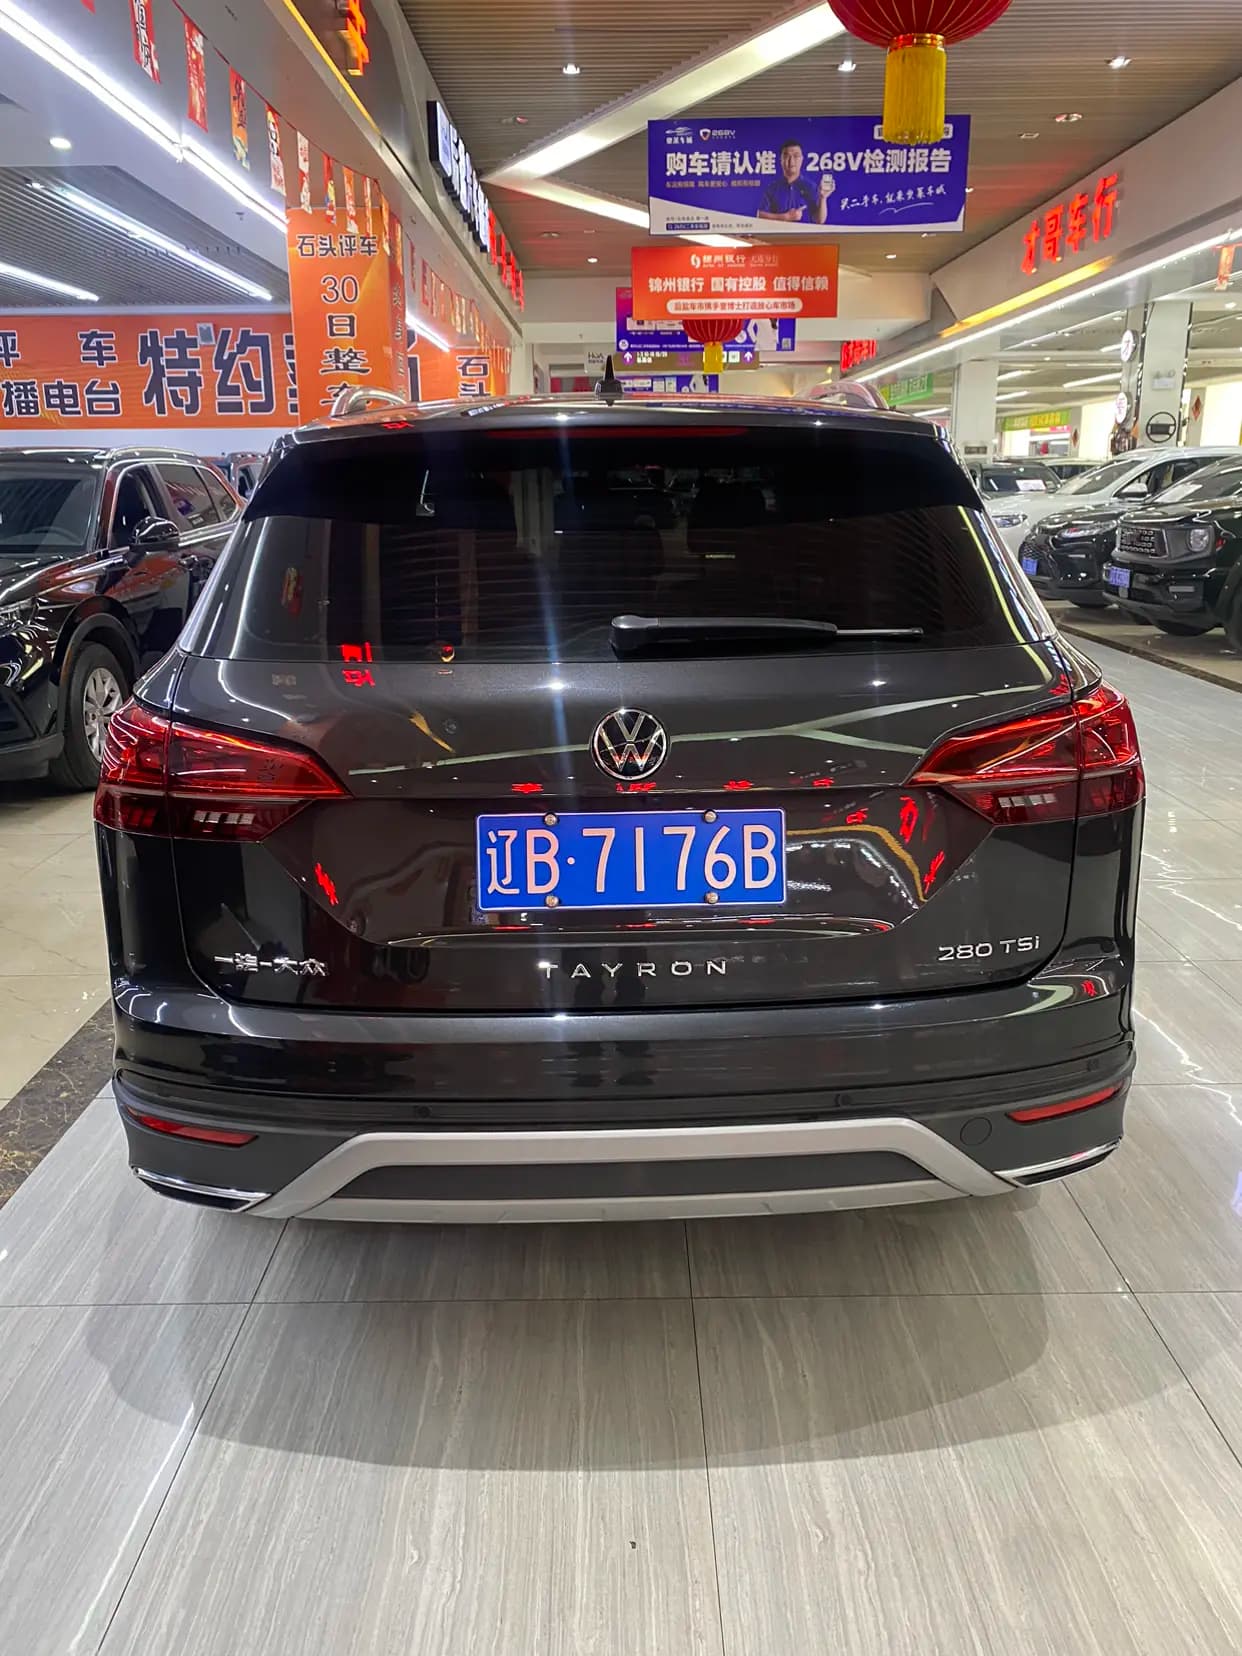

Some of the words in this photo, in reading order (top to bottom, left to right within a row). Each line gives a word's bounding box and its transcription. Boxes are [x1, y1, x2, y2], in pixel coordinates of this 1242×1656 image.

[665, 150, 777, 176] 购车请认准
[806, 148, 953, 174] 268V检测报告
[297, 234, 380, 258] 石头评车
[648, 276, 704, 293] 锦州银行
[710, 275, 767, 292] 国有控股
[773, 275, 829, 292] 值得信赖
[138, 328, 299, 416] 特约
[486, 824, 777, 895] 辽B·7176B
[938, 943, 993, 961] 280
[999, 935, 1040, 954] TSi
[537, 960, 726, 979] TAYRON
